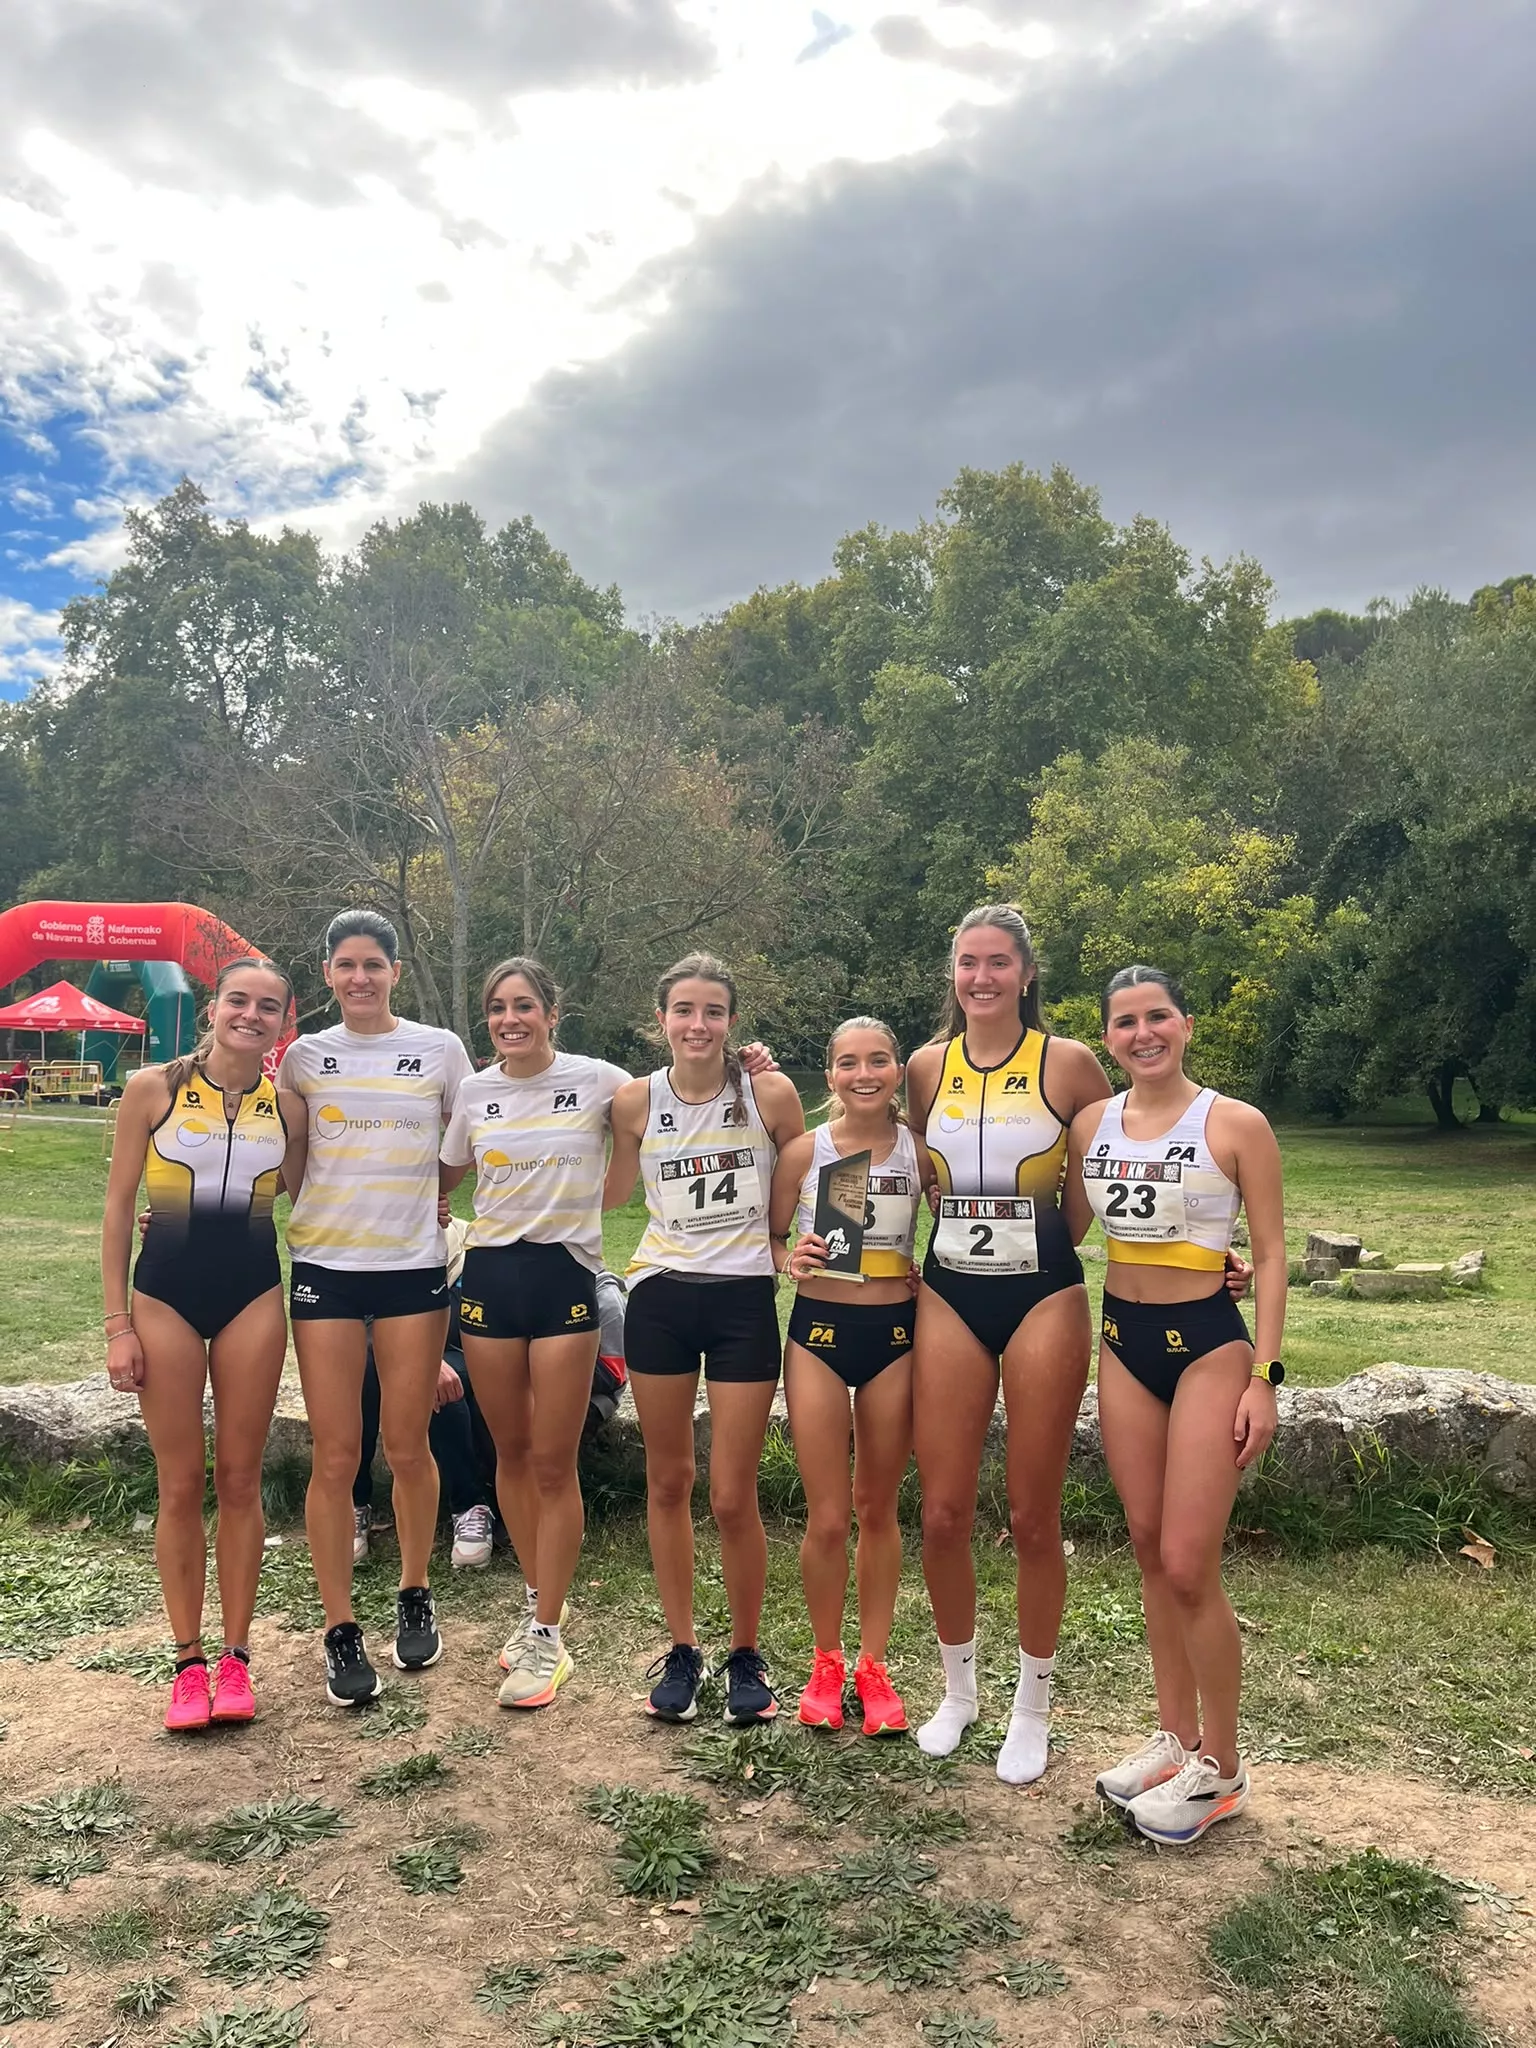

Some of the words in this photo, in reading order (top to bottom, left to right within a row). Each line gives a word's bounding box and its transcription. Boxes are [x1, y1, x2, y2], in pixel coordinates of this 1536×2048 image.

[39, 920, 83, 932] Gobierno
[108, 923, 162, 935] Nafarroako
[32, 931, 44, 941] de
[46, 932, 83, 944] Navarra
[108, 935, 157, 946] Gobernua
[396, 1058, 421, 1072] PA
[1004, 1076, 1028, 1090] PA
[255, 1101, 274, 1115] PA
[553, 1093, 578, 1109] PA
[1164, 1146, 1196, 1162] PA
[688, 1172, 738, 1210] 14
[1105, 1183, 1157, 1219] 23
[969, 1224, 995, 1256] 2
[460, 1302, 483, 1322] PA
[808, 1327, 835, 1343] PA
[1103, 1320, 1119, 1340] PA
